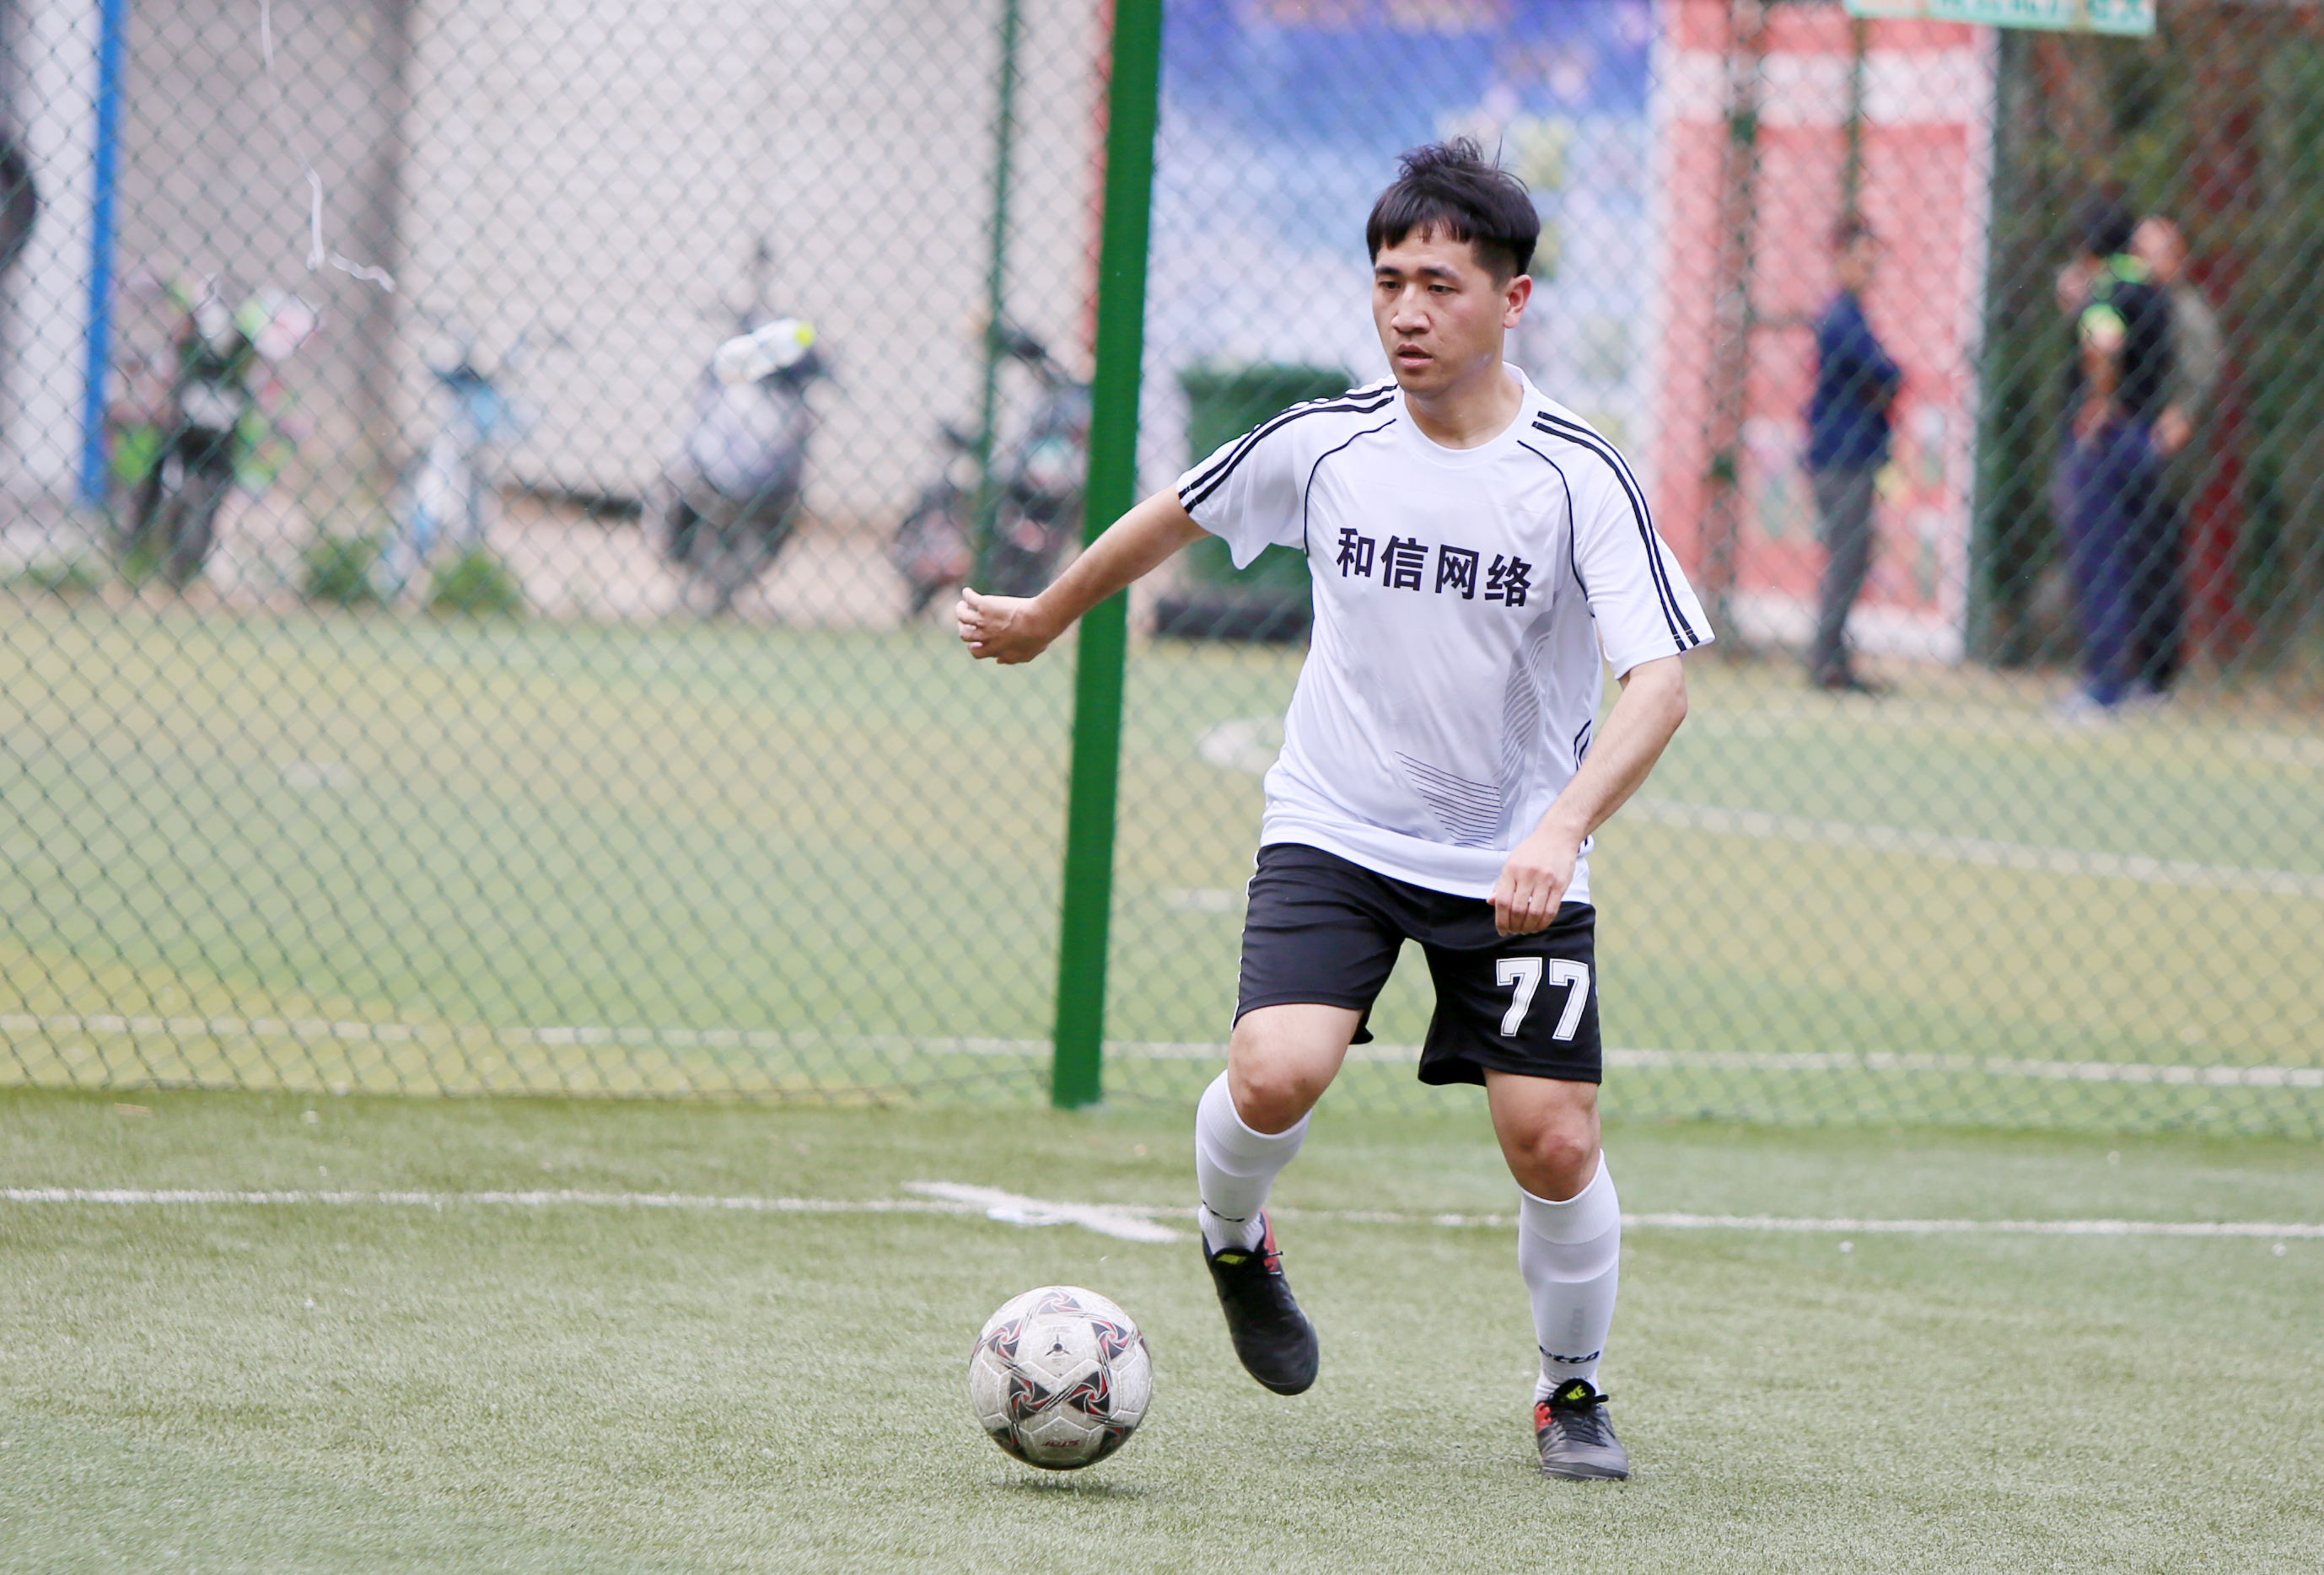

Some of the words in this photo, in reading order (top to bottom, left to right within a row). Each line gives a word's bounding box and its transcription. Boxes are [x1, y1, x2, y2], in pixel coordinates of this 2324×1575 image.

[1336, 527, 1532, 607] 和信网络
[1496, 957, 1590, 1041] 77
